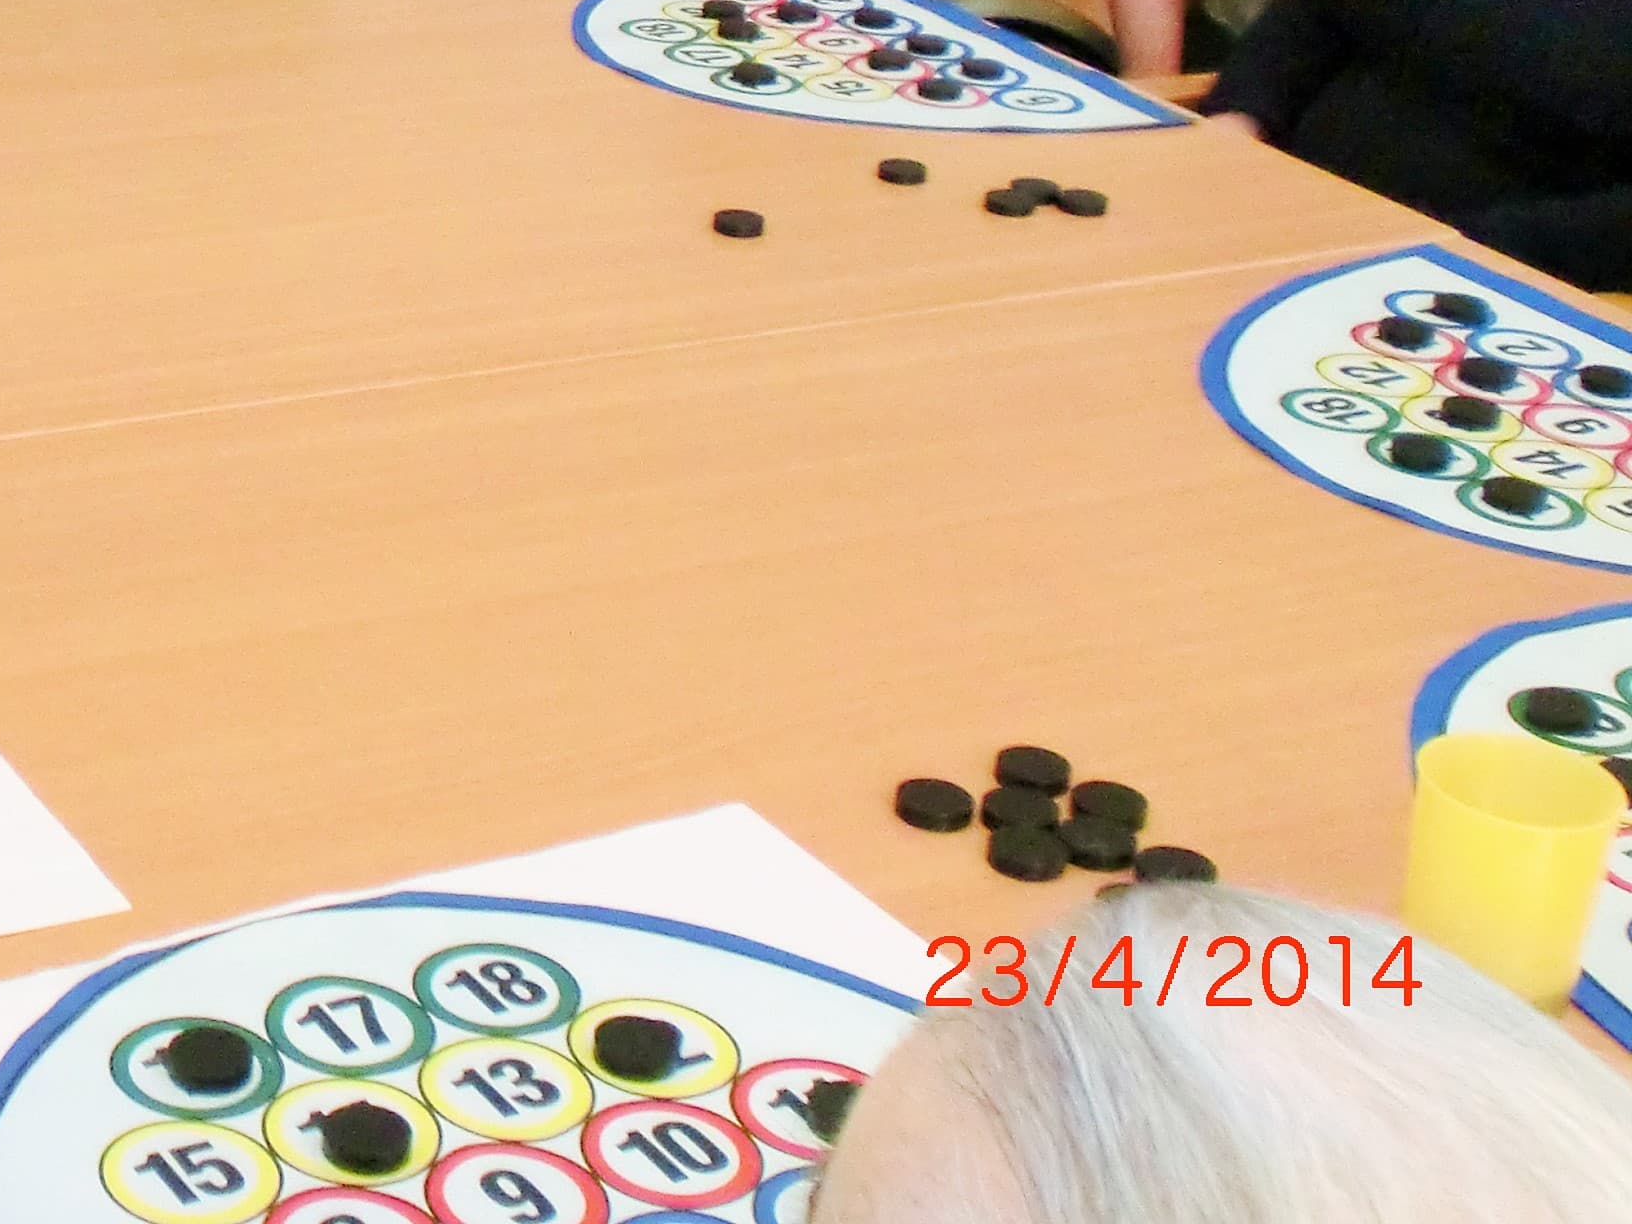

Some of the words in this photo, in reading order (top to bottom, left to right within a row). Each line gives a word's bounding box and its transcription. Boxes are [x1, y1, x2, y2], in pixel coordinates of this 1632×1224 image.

[679, 48, 724, 64] 17
[1339, 361, 1409, 389] 12
[1496, 339, 1553, 356] 2
[1302, 397, 1373, 425] 18
[1512, 449, 1587, 480] 14
[445, 960, 548, 1016] 18
[297, 994, 392, 1055] 17
[451, 1058, 561, 1118] 13
[134, 1142, 245, 1206] 15
[617, 1121, 729, 1183] 10
[480, 1169, 558, 1224] 9
